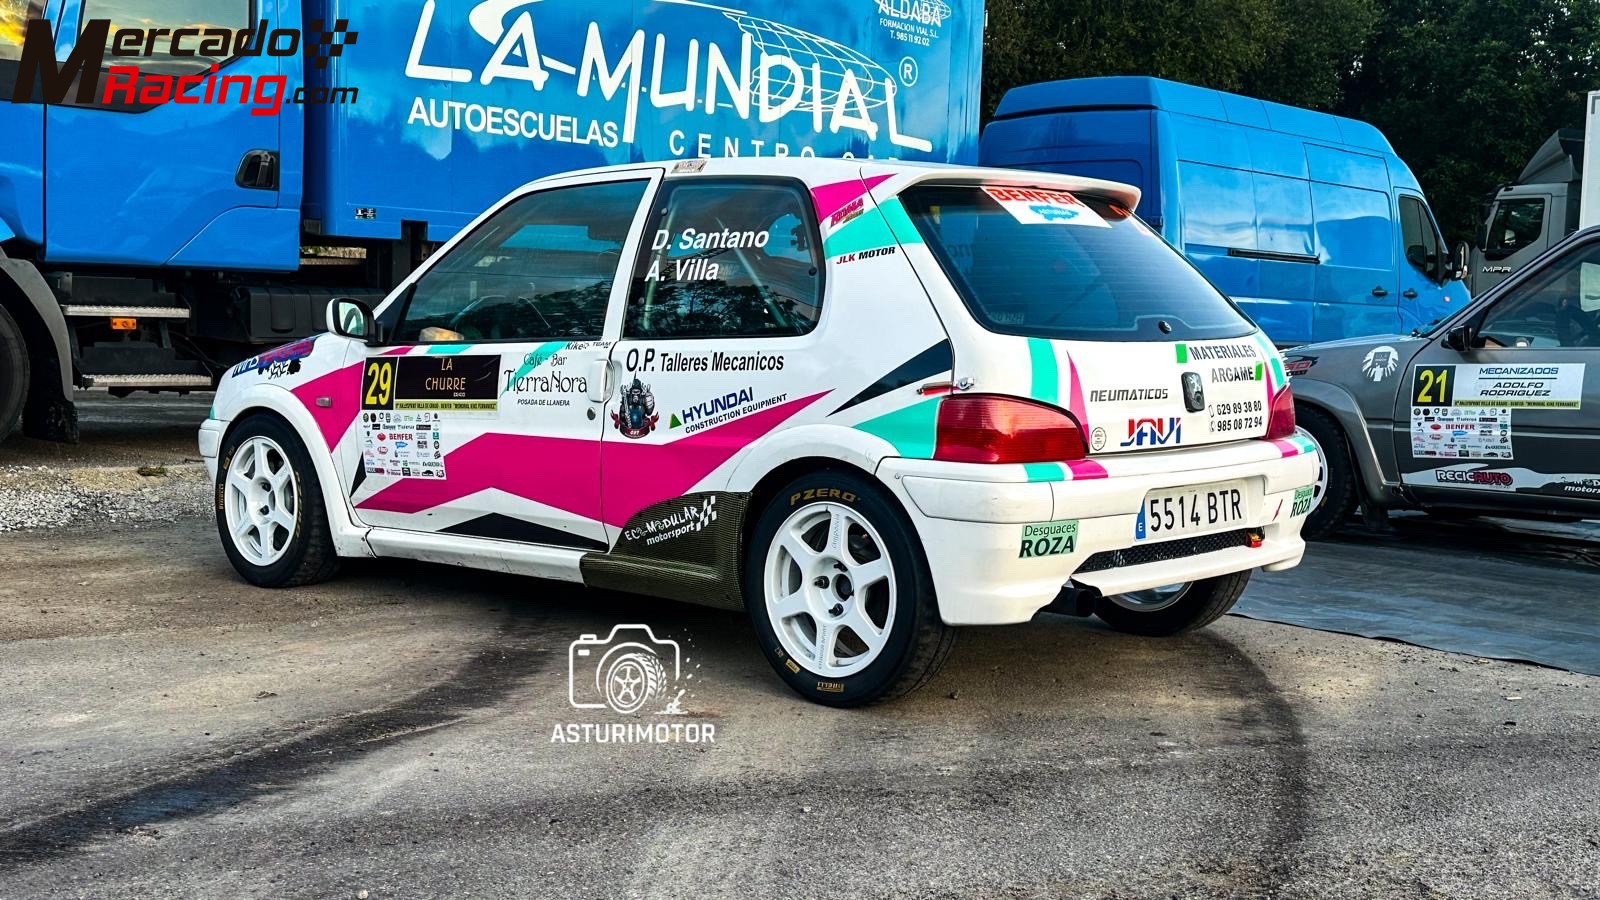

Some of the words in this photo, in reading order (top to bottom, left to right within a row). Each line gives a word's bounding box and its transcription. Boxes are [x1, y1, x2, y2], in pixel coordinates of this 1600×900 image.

[878, 0, 941, 27] ALDABA
[880, 18, 915, 32] FORMACION
[916, 26, 928, 35] VIAL
[896, 31, 907, 41] 985
[408, 97, 619, 149] AUTOESCUELAS
[987, 188, 1085, 207] BENFER
[652, 230, 671, 250] D.
[679, 228, 769, 250] Santano
[836, 253, 855, 264] JLK
[858, 246, 896, 260] MOTOR
[645, 260, 665, 282] A.
[675, 259, 720, 281] Villa
[524, 353, 542, 368] Café
[551, 353, 567, 366] Bar
[626, 348, 655, 372] O.P.
[661, 353, 708, 372] Talleres
[711, 351, 784, 371] Mecanicos
[1189, 345, 1256, 360] MATERIALES
[441, 358, 453, 370] LA
[1479, 367, 1559, 375] MECANIZADOS
[365, 362, 392, 405] 29
[1212, 366, 1254, 383] ARGAME
[425, 378, 466, 390] CHURRE
[1417, 369, 1448, 402] 21
[1090, 388, 1168, 402] NEUMATICOS
[682, 387, 754, 424] HYUNDAI
[685, 409, 741, 433] CONSTRUCTION
[743, 393, 787, 414] EQUIPMENT
[1217, 403, 1231, 415] 629
[1233, 402, 1242, 414] 89
[1243, 401, 1252, 413] 38
[1253, 400, 1261, 411] 80
[1120, 417, 1181, 446] JAVI
[1217, 419, 1231, 432] 985
[1233, 418, 1242, 430] 08
[1244, 417, 1252, 429] 72
[1254, 416, 1262, 427] 94
[1436, 470, 1513, 486] RECICAUTO
[1150, 494, 1200, 532] 5514
[1207, 489, 1242, 524] BTR
[646, 521, 695, 545] motorsport
[1025, 523, 1076, 538] Desguaces
[1019, 535, 1074, 558] ROZA
